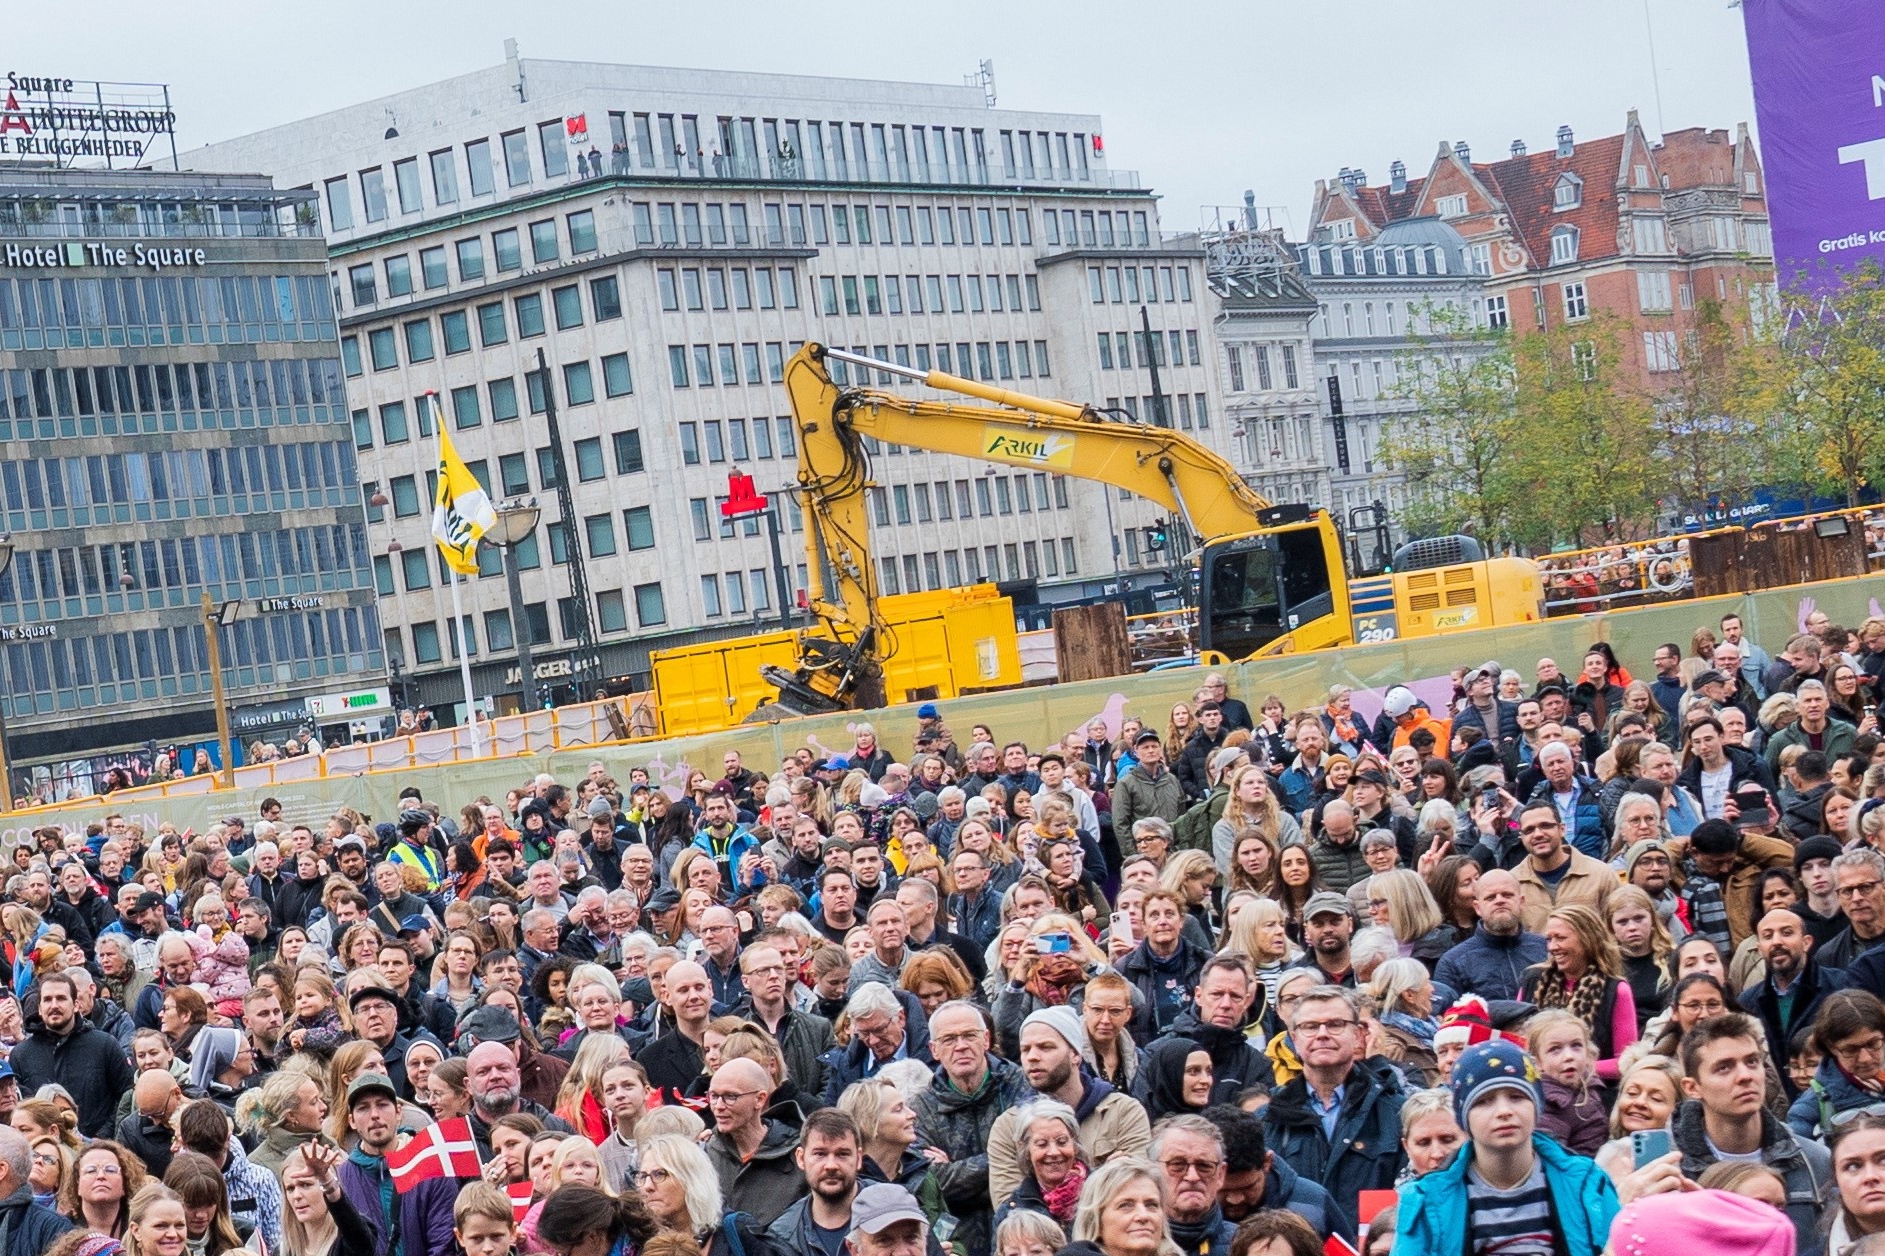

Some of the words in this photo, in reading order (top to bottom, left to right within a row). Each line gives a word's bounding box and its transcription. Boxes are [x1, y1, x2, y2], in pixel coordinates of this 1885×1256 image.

[7, 71, 74, 97] Square
[16, 137, 144, 157] BELIGGENHEDER
[1818, 231, 1867, 253] Gratis
[4, 242, 66, 267] Hotel
[86, 242, 128, 266] The
[133, 242, 206, 272] Square
[987, 435, 1049, 461] ARKIL
[272, 599, 289, 611] The
[291, 595, 324, 611] Square
[18, 624, 57, 641] Square
[1359, 618, 1378, 631] PC
[1359, 627, 1395, 644] 290
[504, 659, 573, 685] JAGER
[241, 711, 272, 727] Hotel
[281, 709, 297, 721] The
